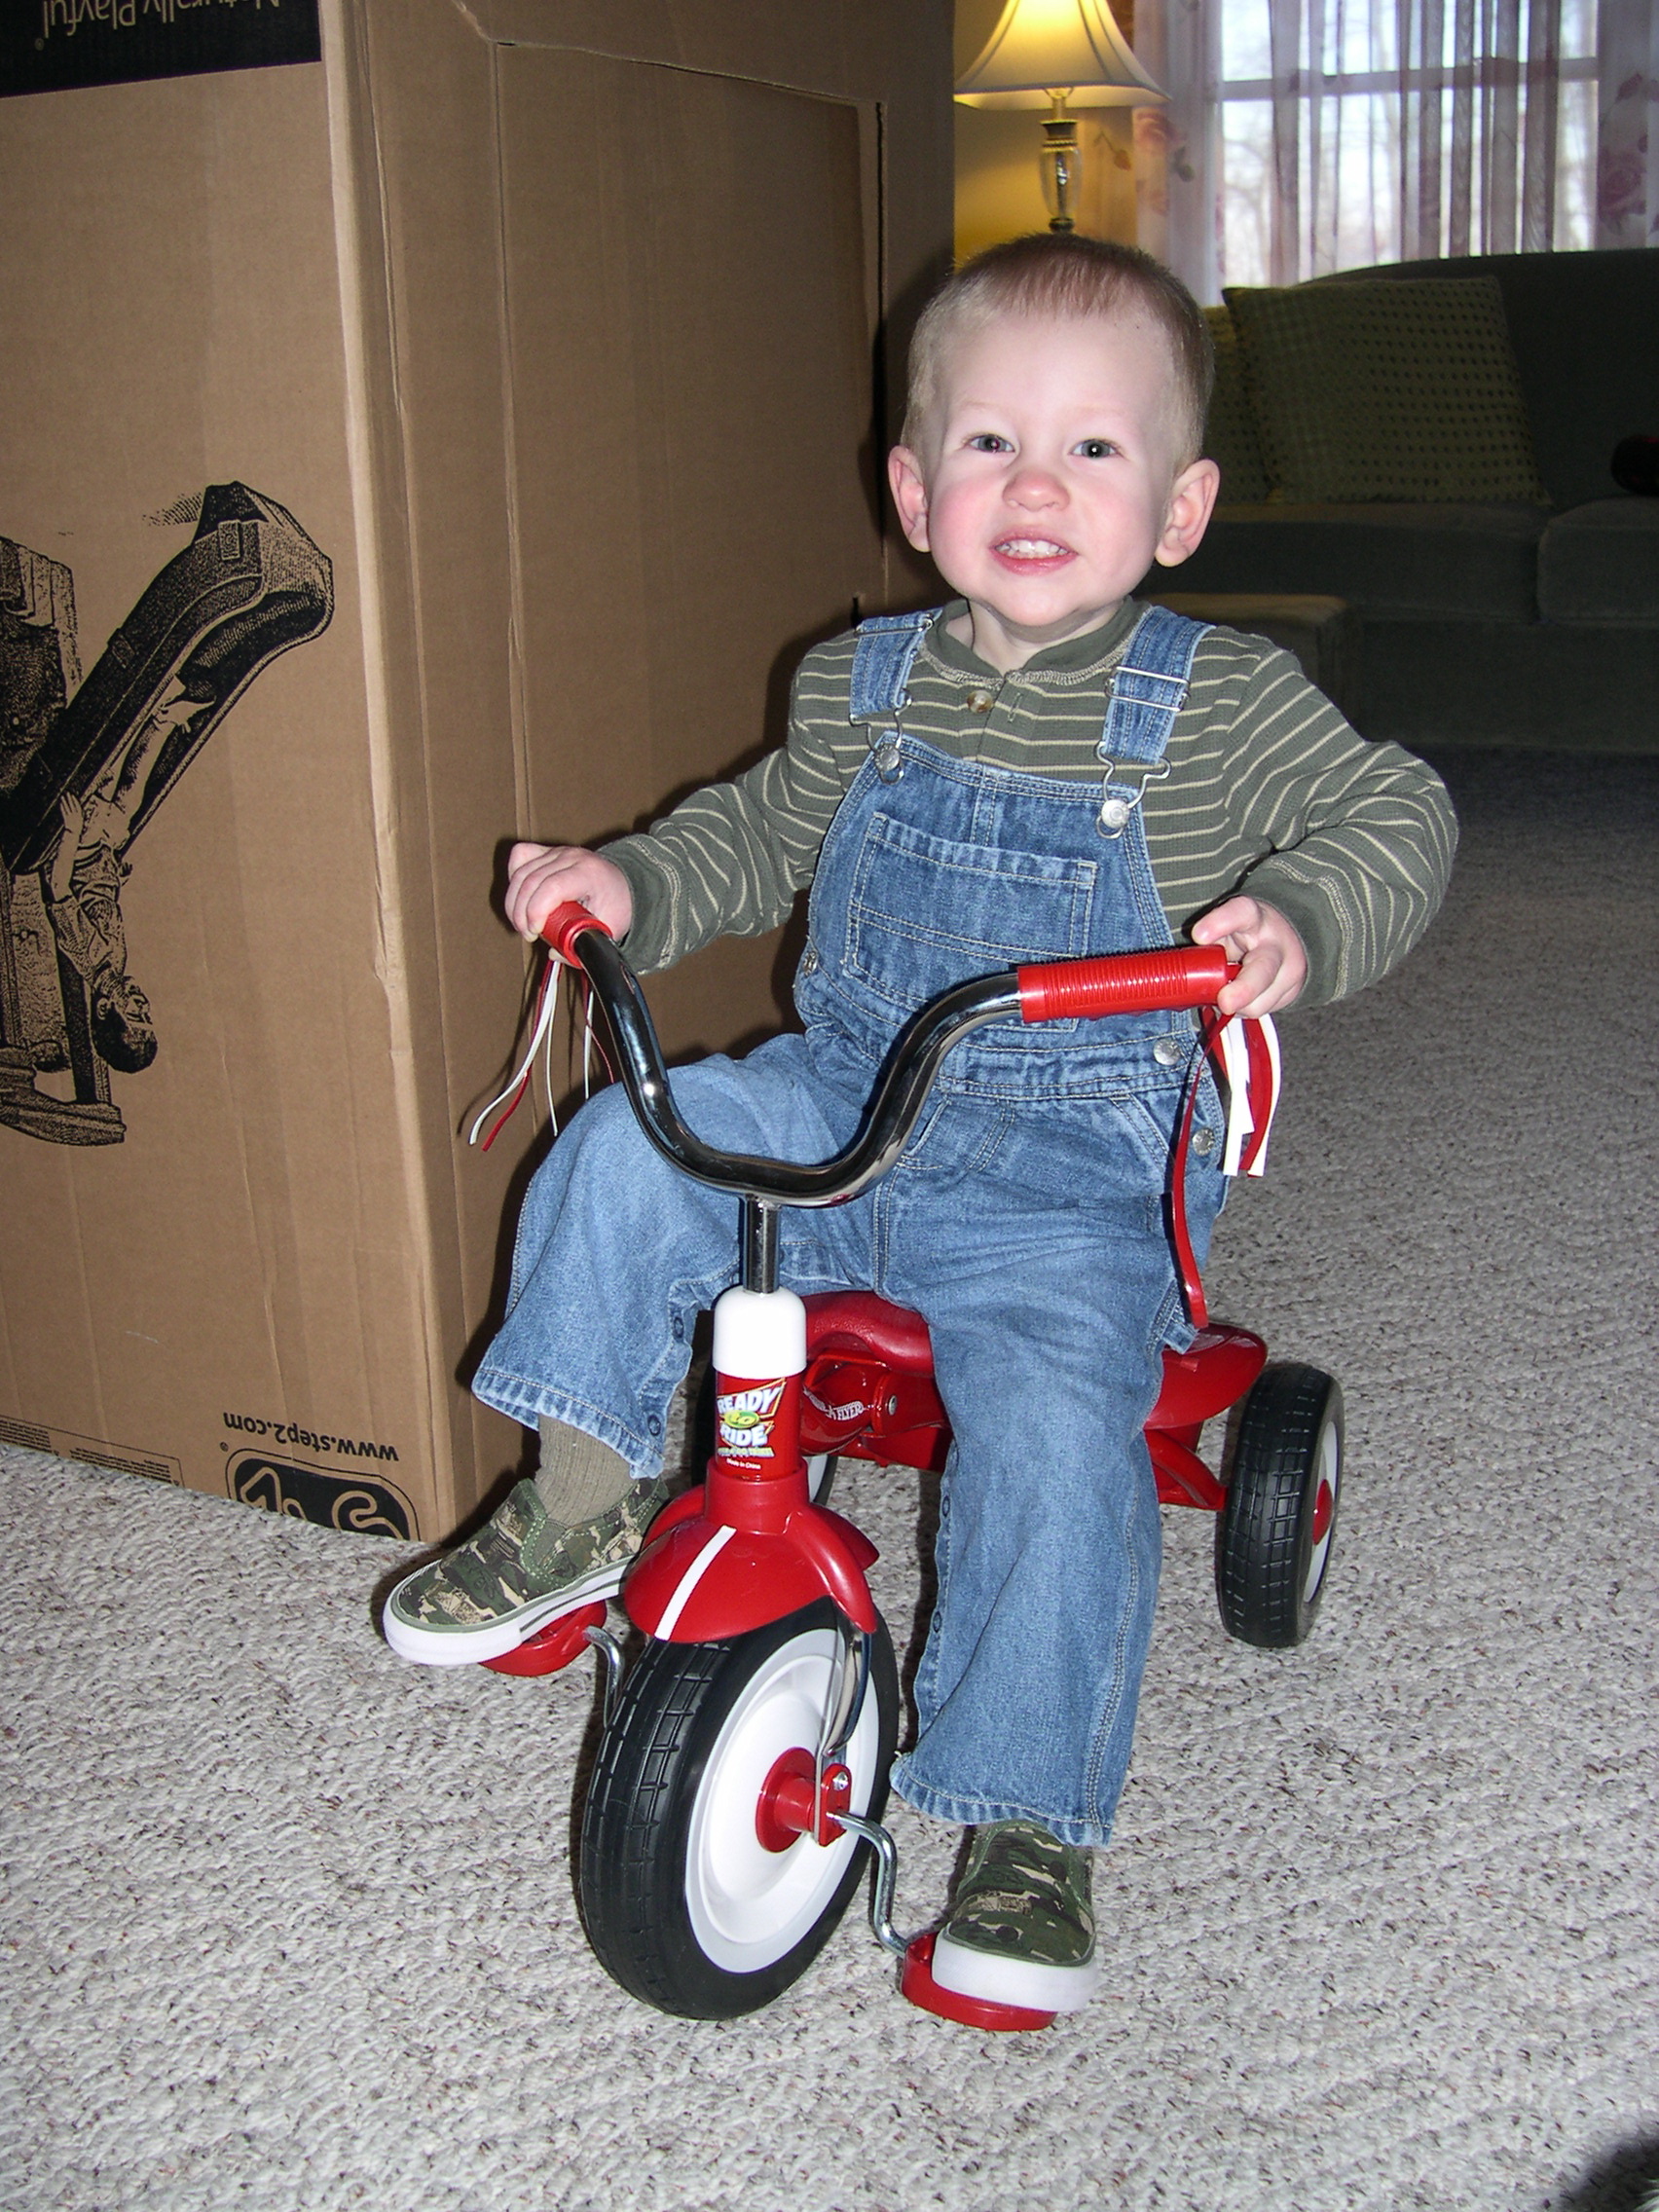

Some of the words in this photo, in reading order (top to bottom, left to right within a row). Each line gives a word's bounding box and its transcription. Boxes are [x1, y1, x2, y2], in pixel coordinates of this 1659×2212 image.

[43, 0, 135, 38] Playful
[717, 1386, 783, 1414] READY
[223, 1412, 399, 1461] www.step2.com
[719, 1422, 767, 1447] RIDE
